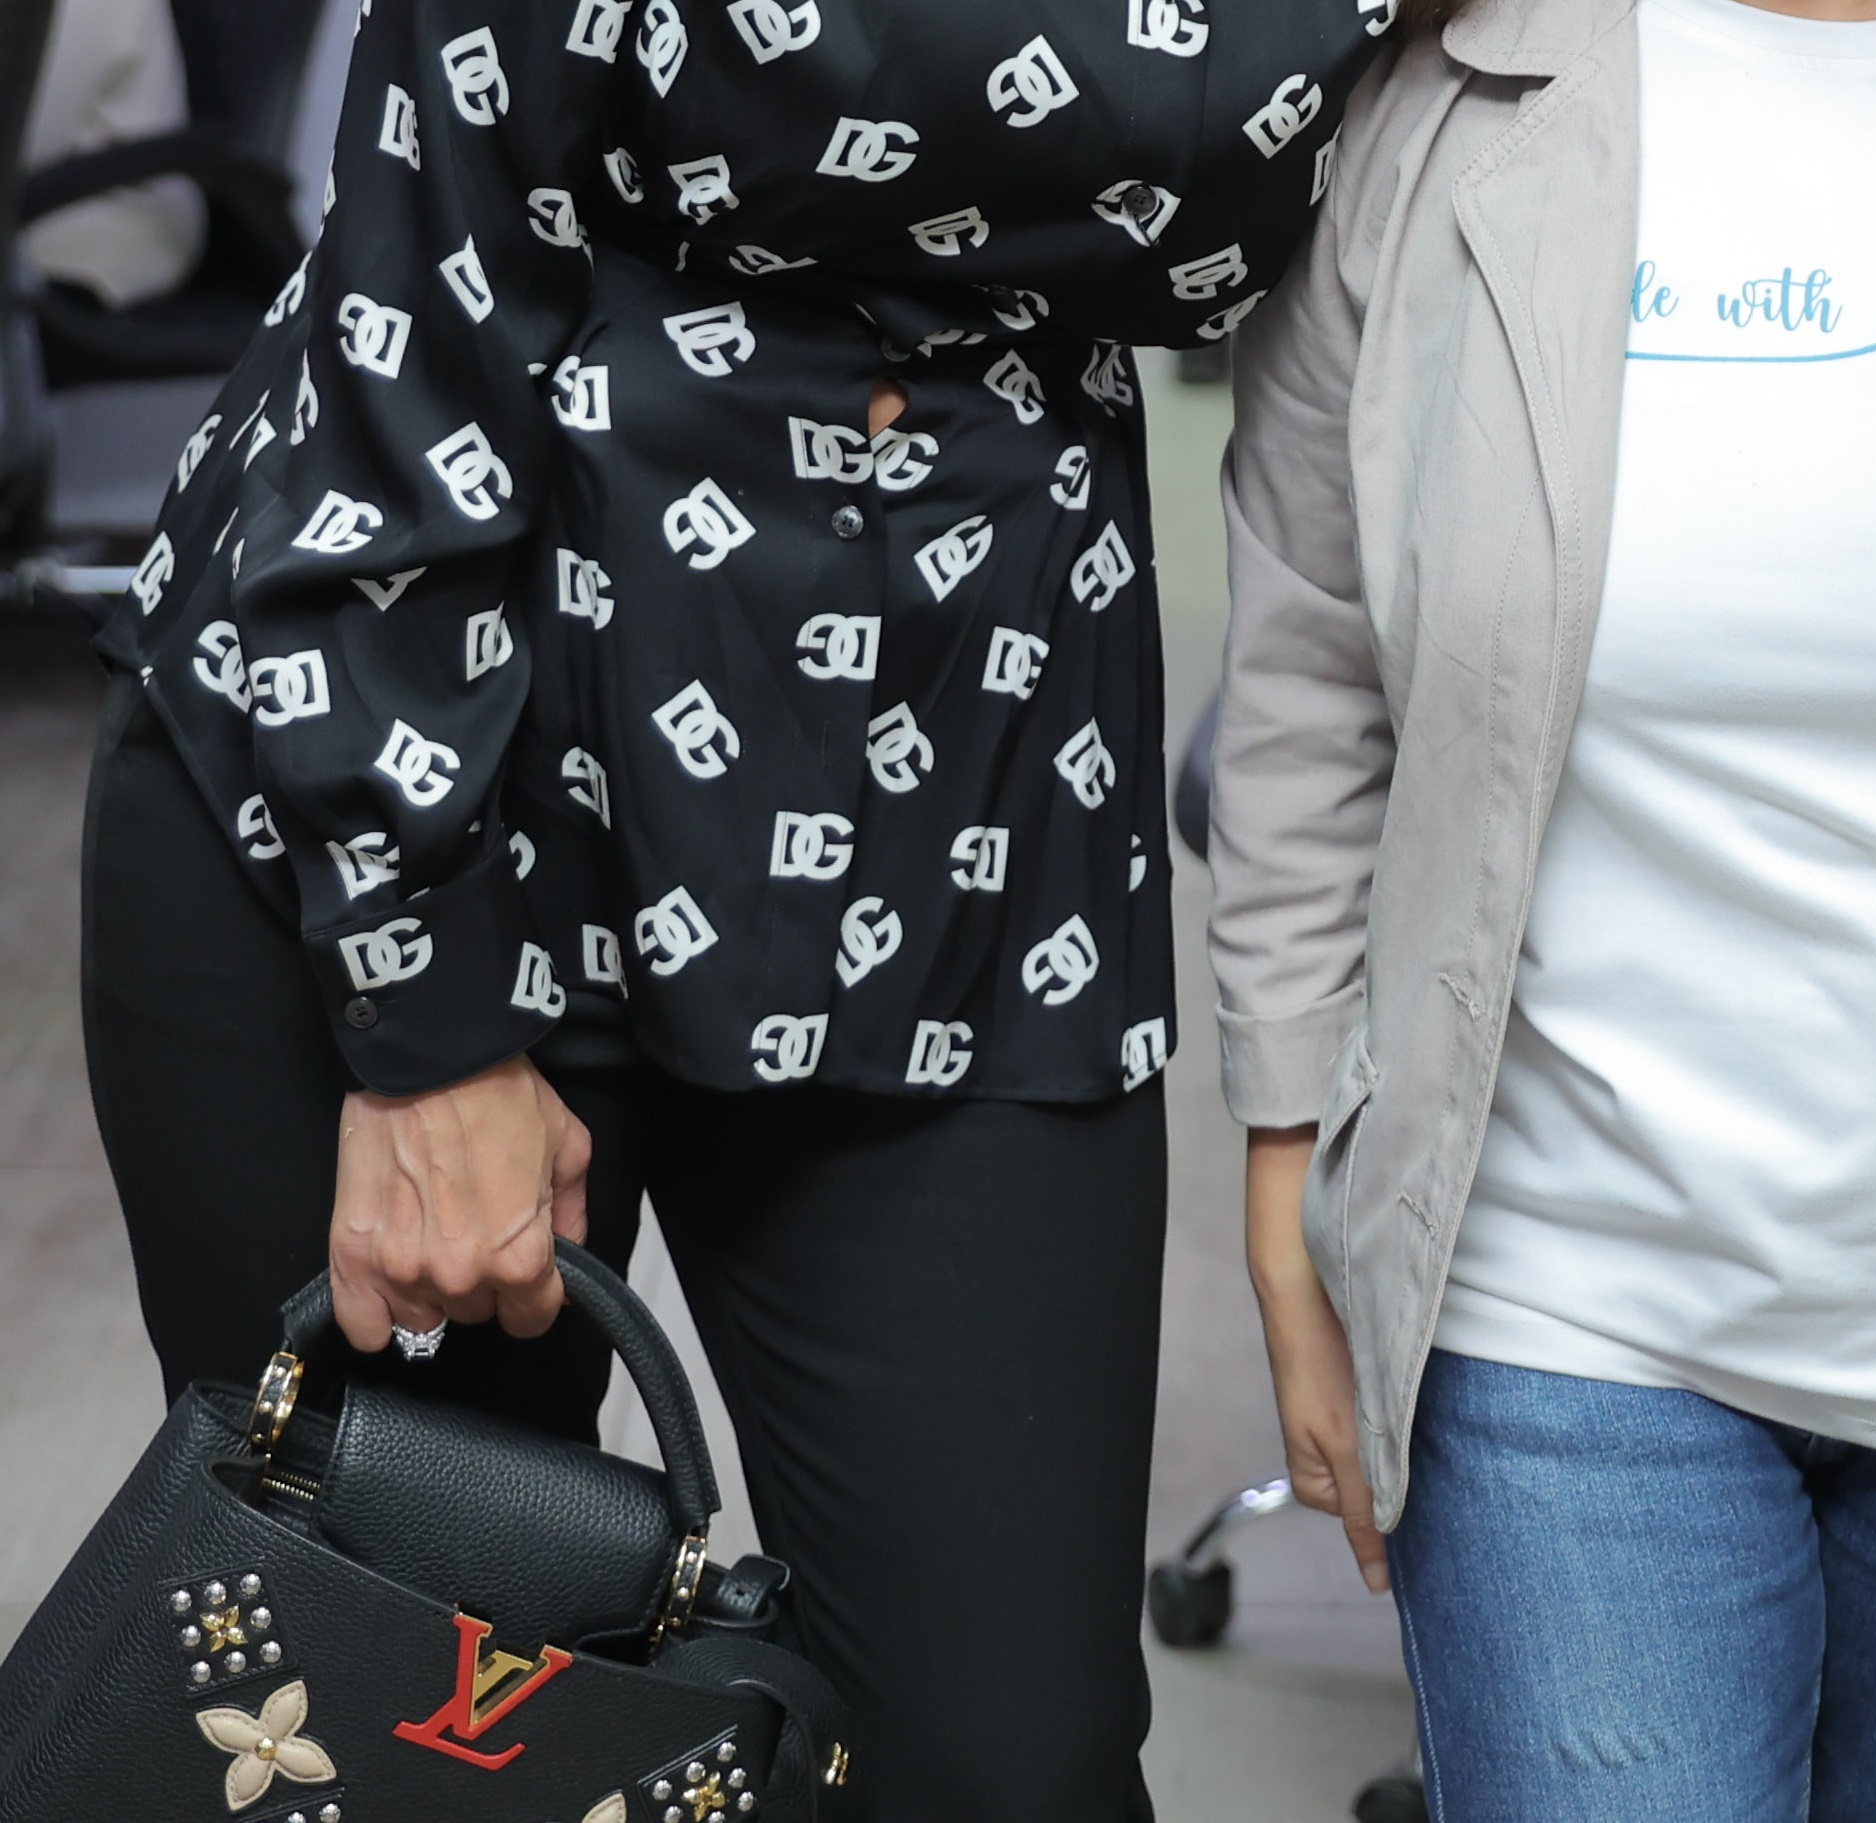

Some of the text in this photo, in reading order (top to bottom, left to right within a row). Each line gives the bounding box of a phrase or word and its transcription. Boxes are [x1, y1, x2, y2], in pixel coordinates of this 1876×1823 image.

[441, 26, 509, 125] DG
[987, 34, 1079, 127] DG
[1242, 74, 1322, 158] DG
[816, 117, 919, 181] DG
[338, 293, 412, 379] DG
[663, 302, 755, 377] DG
[1717, 266, 1843, 333] with
[425, 422, 512, 521] DG
[790, 418, 874, 480] DG
[291, 490, 383, 555] DG
[663, 477, 756, 570] DG
[914, 516, 993, 602] DG
[1071, 520, 1135, 611] DG
[248, 649, 330, 726] DG
[796, 613, 881, 681] DG
[373, 718, 460, 807] DG
[652, 679, 740, 779] DG
[770, 811, 854, 880] DG
[338, 918, 432, 990] DG
[635, 886, 719, 976] DG
[1022, 914, 1099, 1005] DG
[751, 1014, 828, 1082] DG
[905, 1020, 973, 1086] DG
